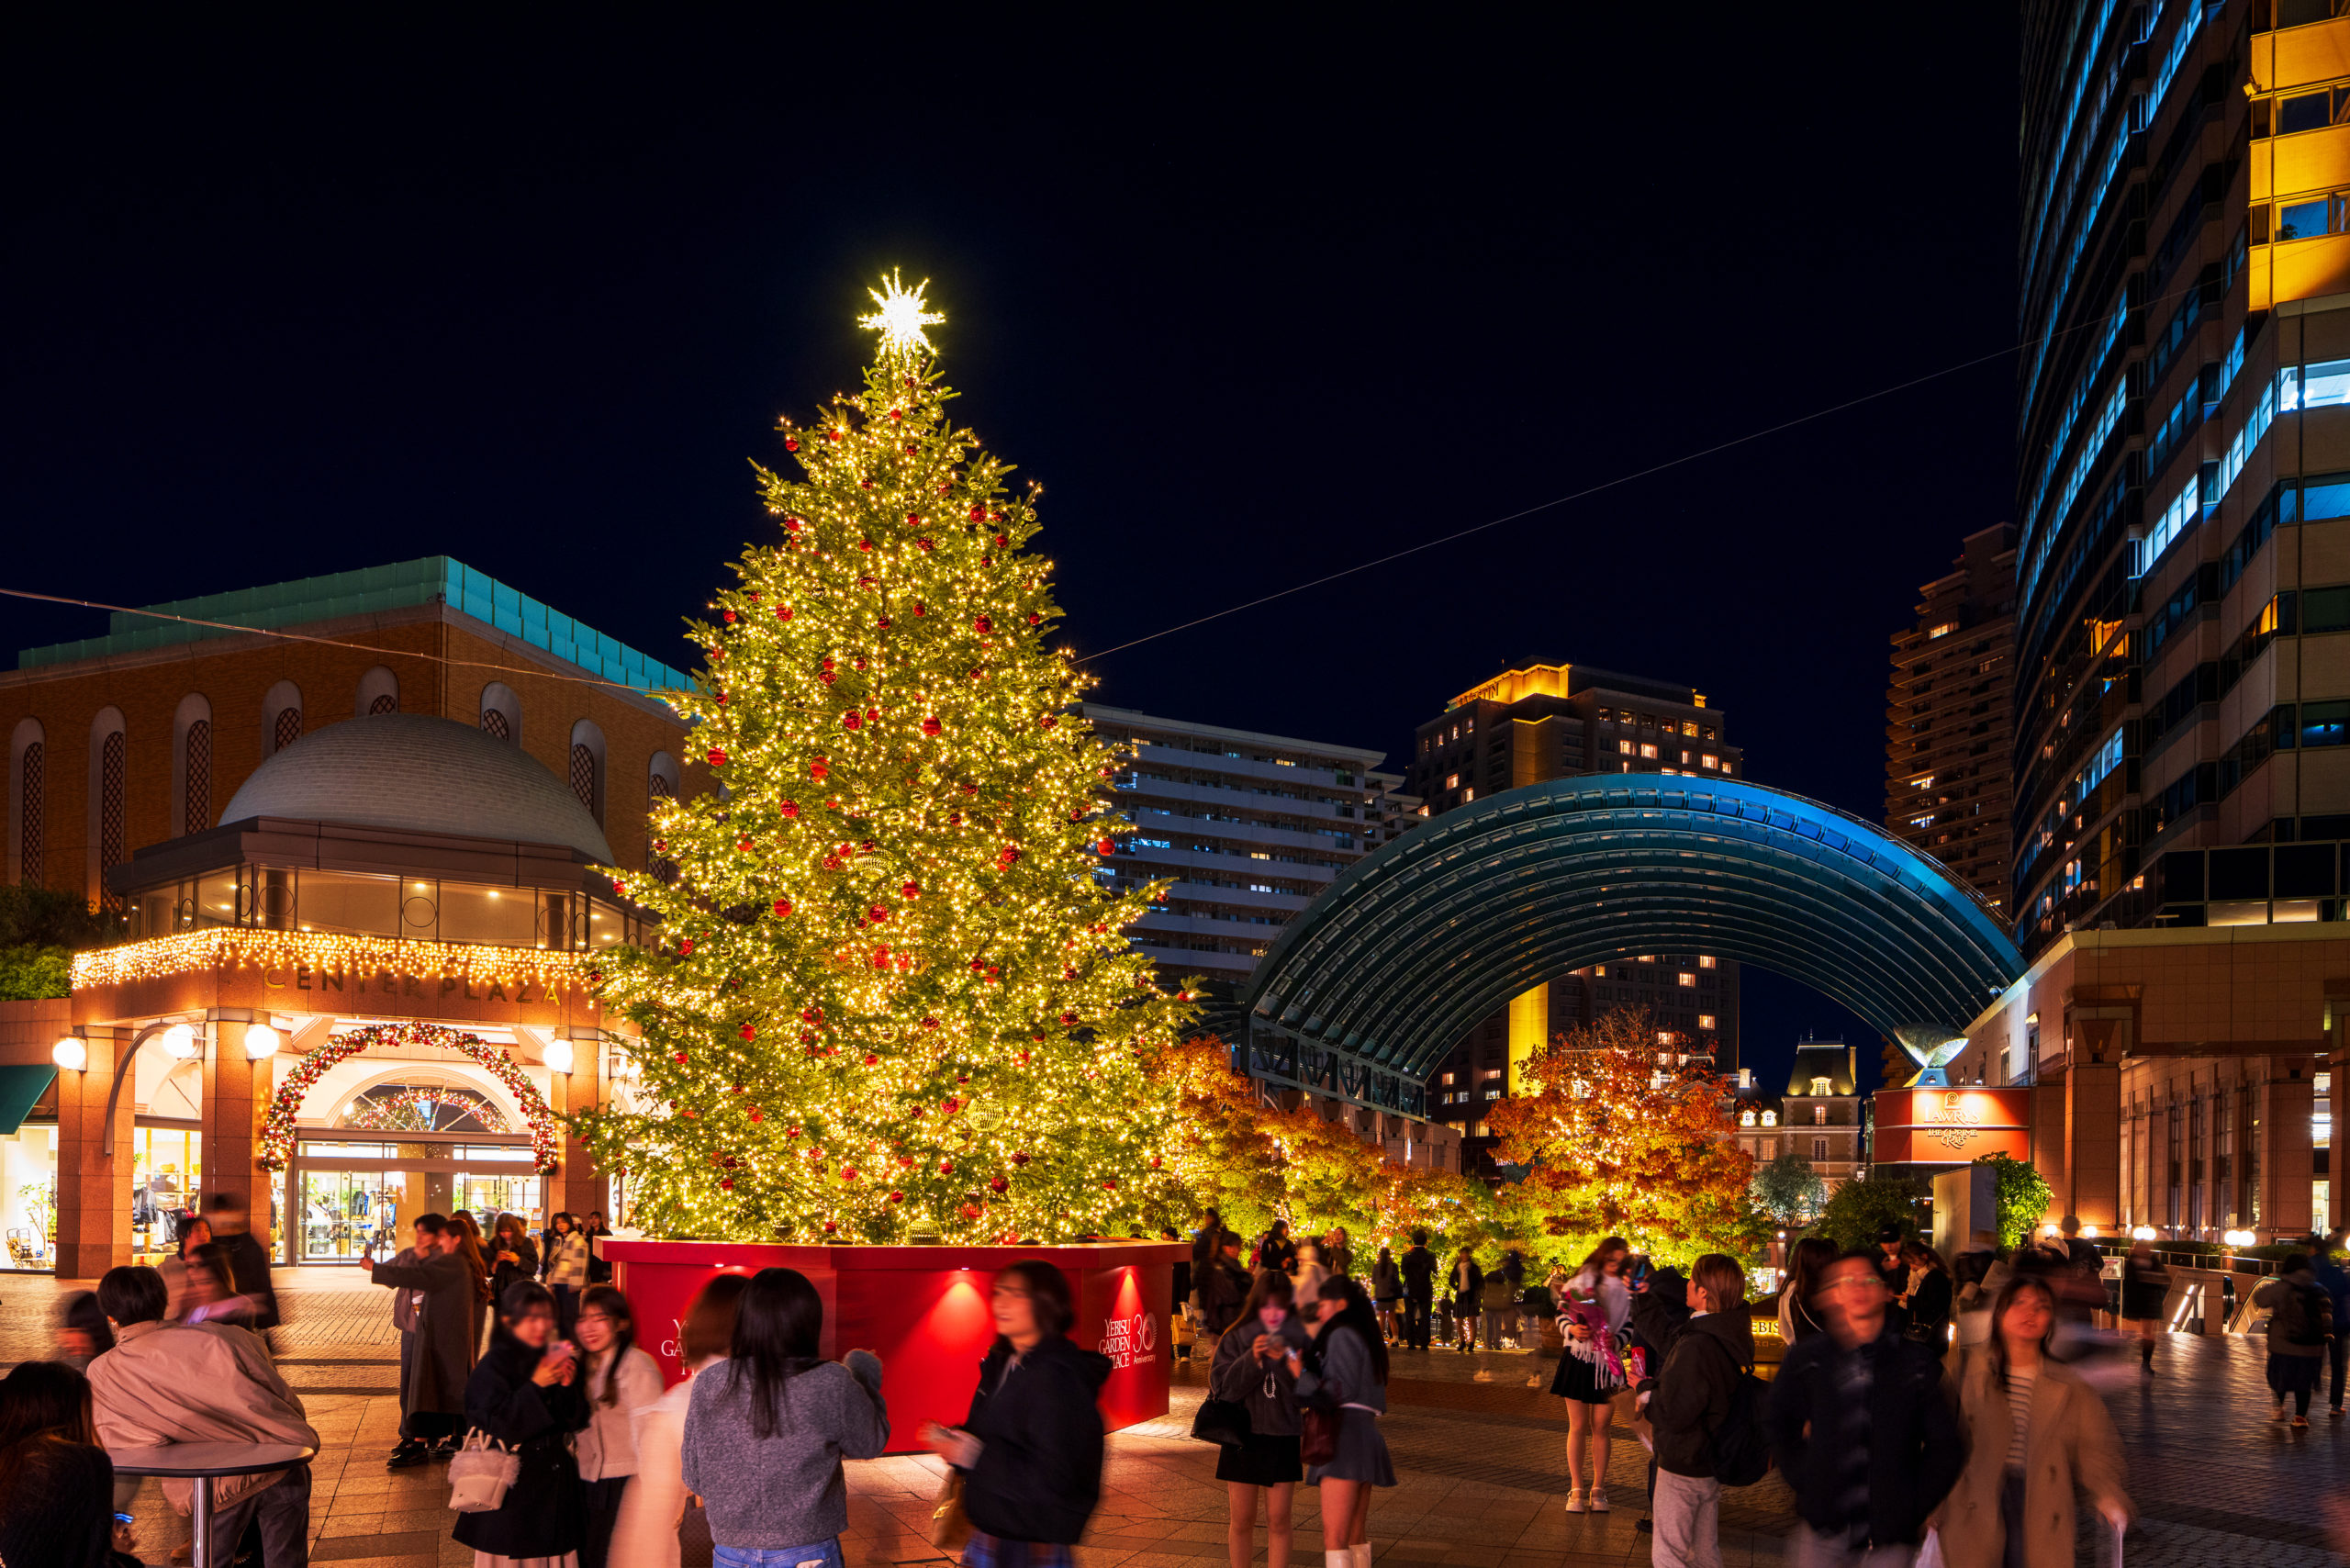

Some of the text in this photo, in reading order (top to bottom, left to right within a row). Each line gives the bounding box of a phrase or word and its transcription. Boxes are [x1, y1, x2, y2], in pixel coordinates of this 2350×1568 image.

[263, 965, 561, 1006] CENTER PLAZA
[1104, 1317, 1131, 1337] YEBISU
[1133, 1313, 1158, 1353] 30
[1751, 1322, 1779, 1333] EBIS
[1099, 1336, 1131, 1355] GARDEN
[1133, 1353, 1157, 1365] Anniversary
